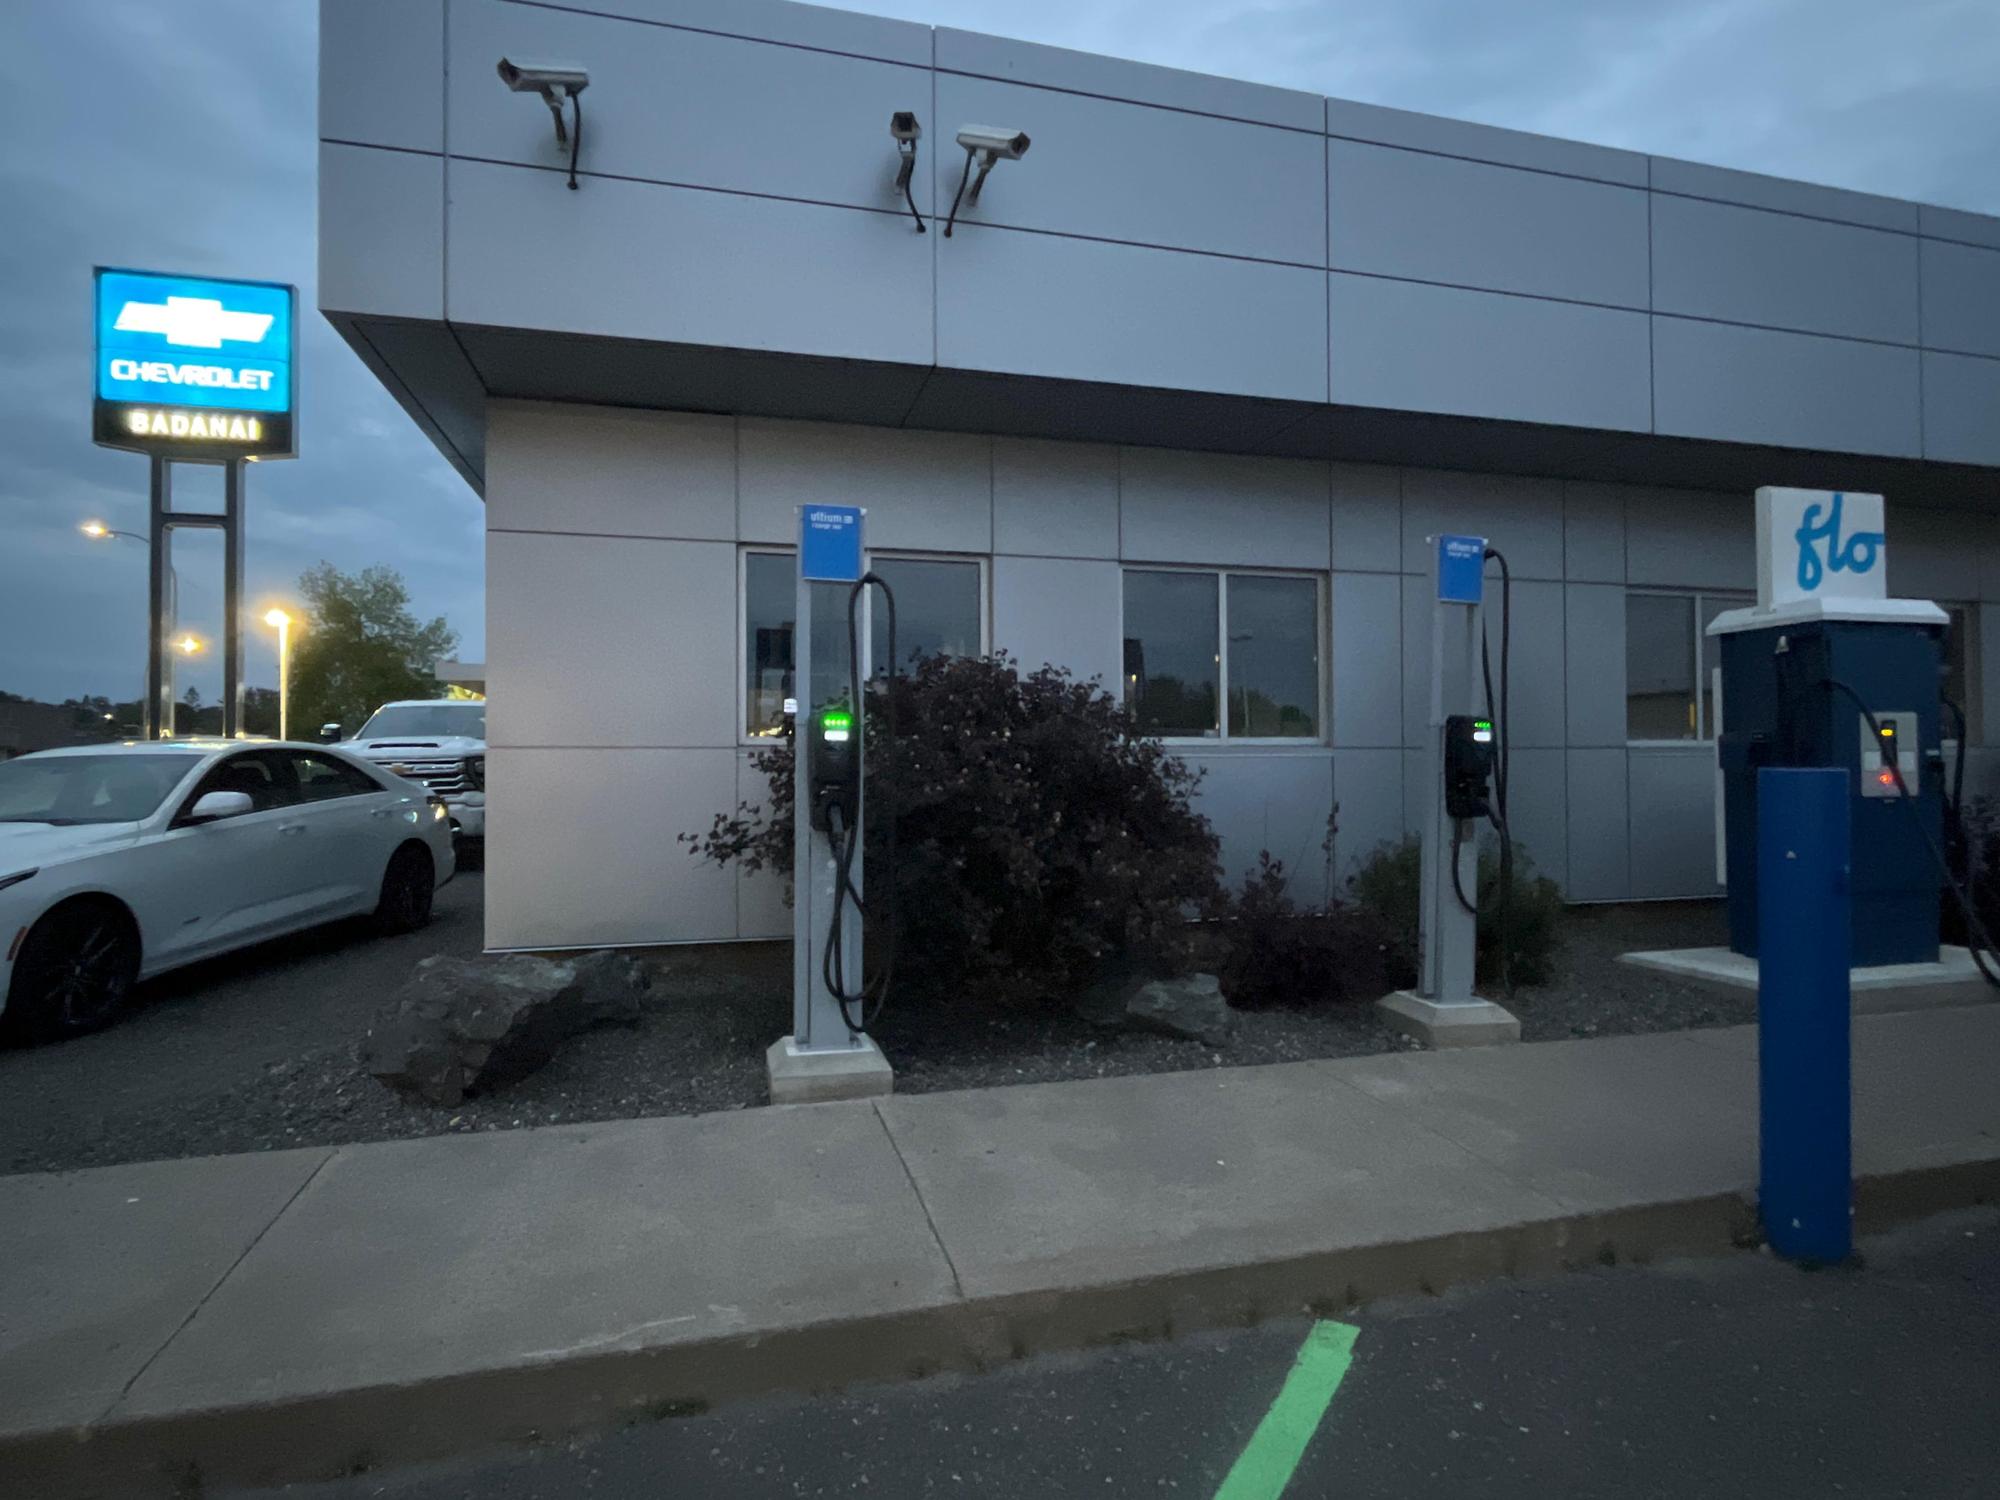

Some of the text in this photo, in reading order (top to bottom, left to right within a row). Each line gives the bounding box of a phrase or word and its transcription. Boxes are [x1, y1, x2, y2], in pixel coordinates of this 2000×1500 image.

[110, 359, 274, 390] CHEVROLET
[129, 409, 261, 440] BADANAI
[1794, 492, 1886, 591] flo
